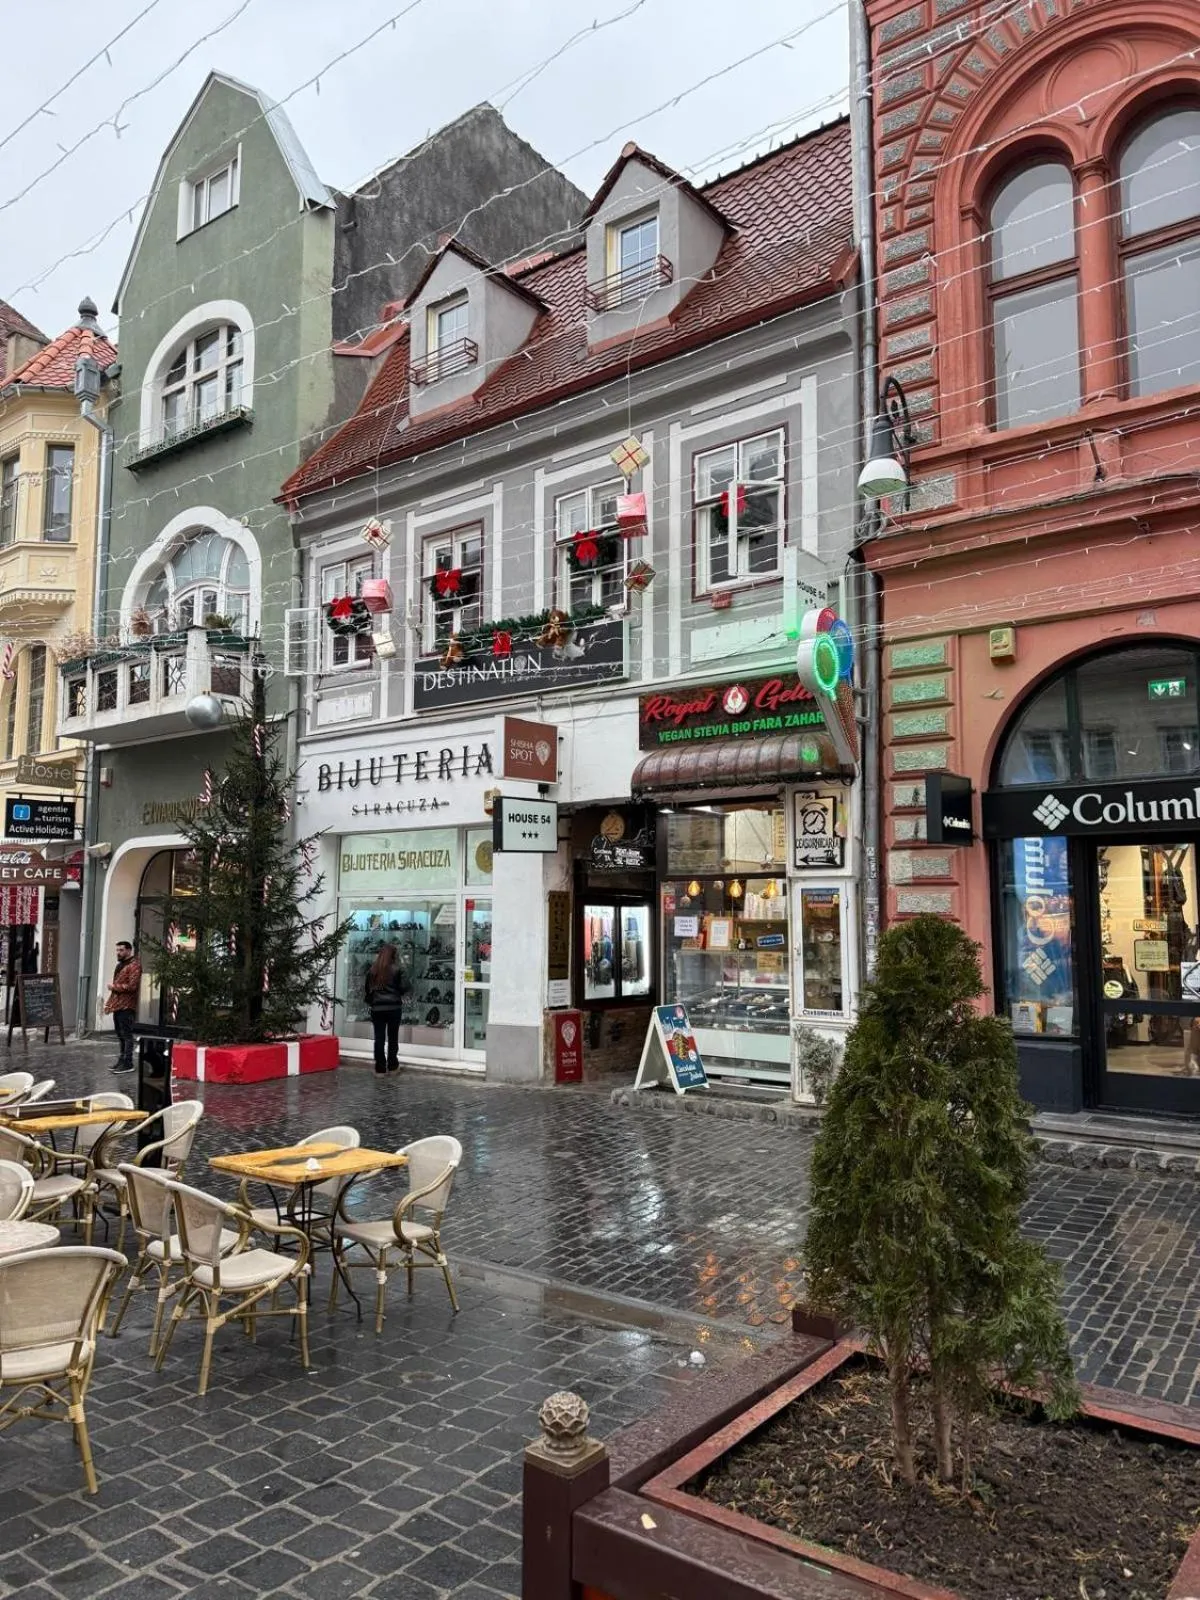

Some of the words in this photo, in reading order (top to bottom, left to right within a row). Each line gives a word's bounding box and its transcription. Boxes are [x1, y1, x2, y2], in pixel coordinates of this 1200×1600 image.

[642, 692, 717, 724] Royal
[658, 729, 692, 743] VEGAN
[694, 724, 730, 738] STEVIA
[731, 722, 750, 733] BIO
[752, 717, 782, 732] FARA
[784, 711, 824, 728] ZAHAR
[510, 748, 535, 762] SPOT
[318, 743, 493, 792] BIJUTERIA
[351, 796, 440, 816] SIRACUZA
[41, 815, 71, 823] turism
[508, 813, 538, 824] HOUSE
[540, 814, 551, 825] 54
[9, 824, 35, 834] Active
[35, 825, 69, 836] Holidays
[342, 853, 396, 873] BIJUTERIA
[398, 849, 451, 870] SIRACUZA
[24, 868, 62, 879] CAFE
